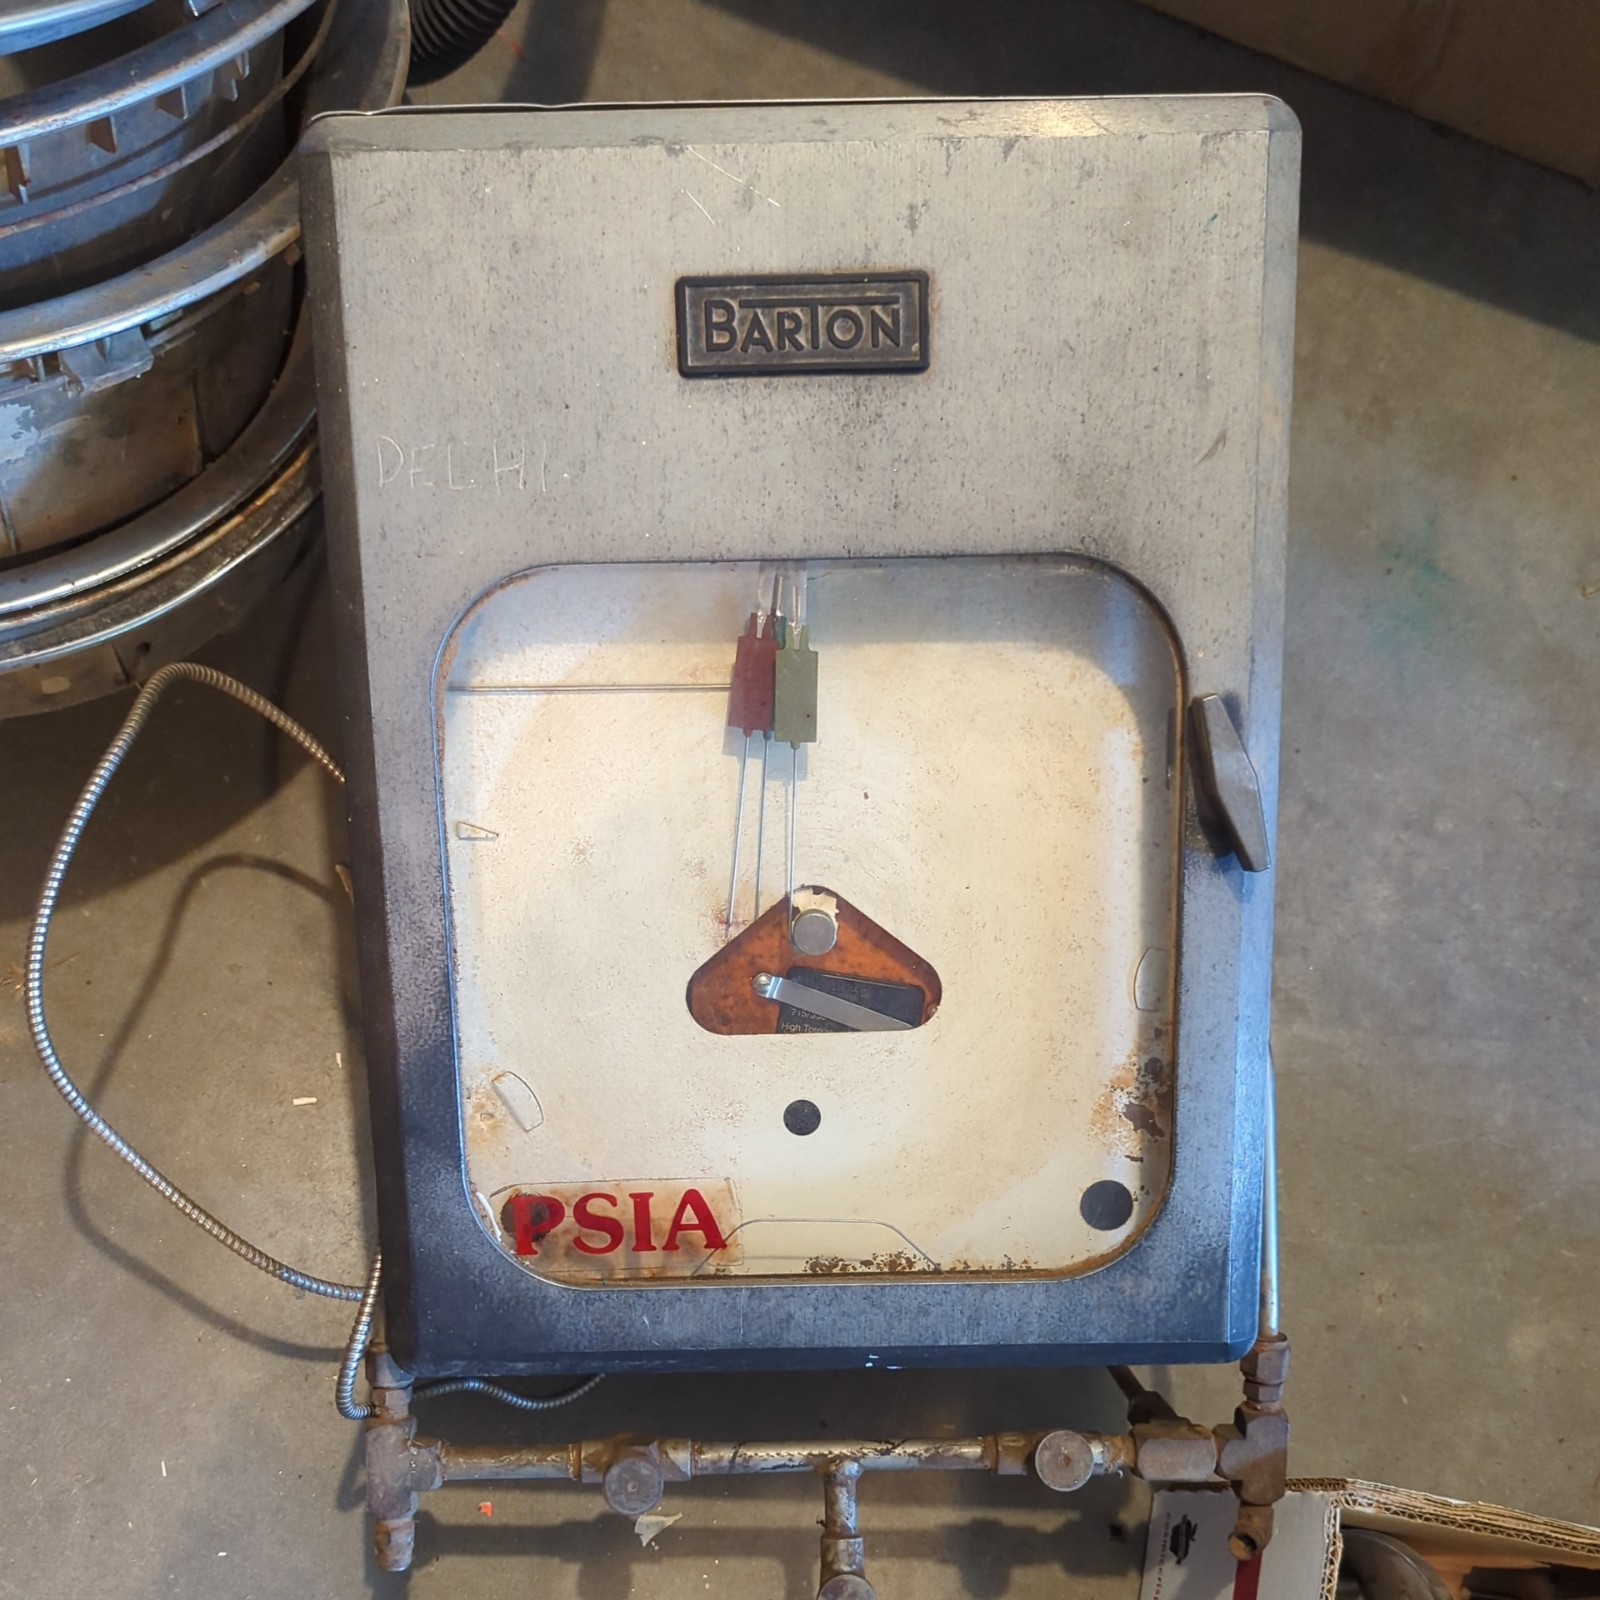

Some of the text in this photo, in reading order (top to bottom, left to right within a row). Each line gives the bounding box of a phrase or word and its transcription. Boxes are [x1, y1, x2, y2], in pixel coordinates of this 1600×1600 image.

[704, 297, 901, 352] BARTON
[376, 435, 548, 494] DELHI
[781, 1021, 802, 1034] High
[512, 1188, 728, 1256] PSIA
